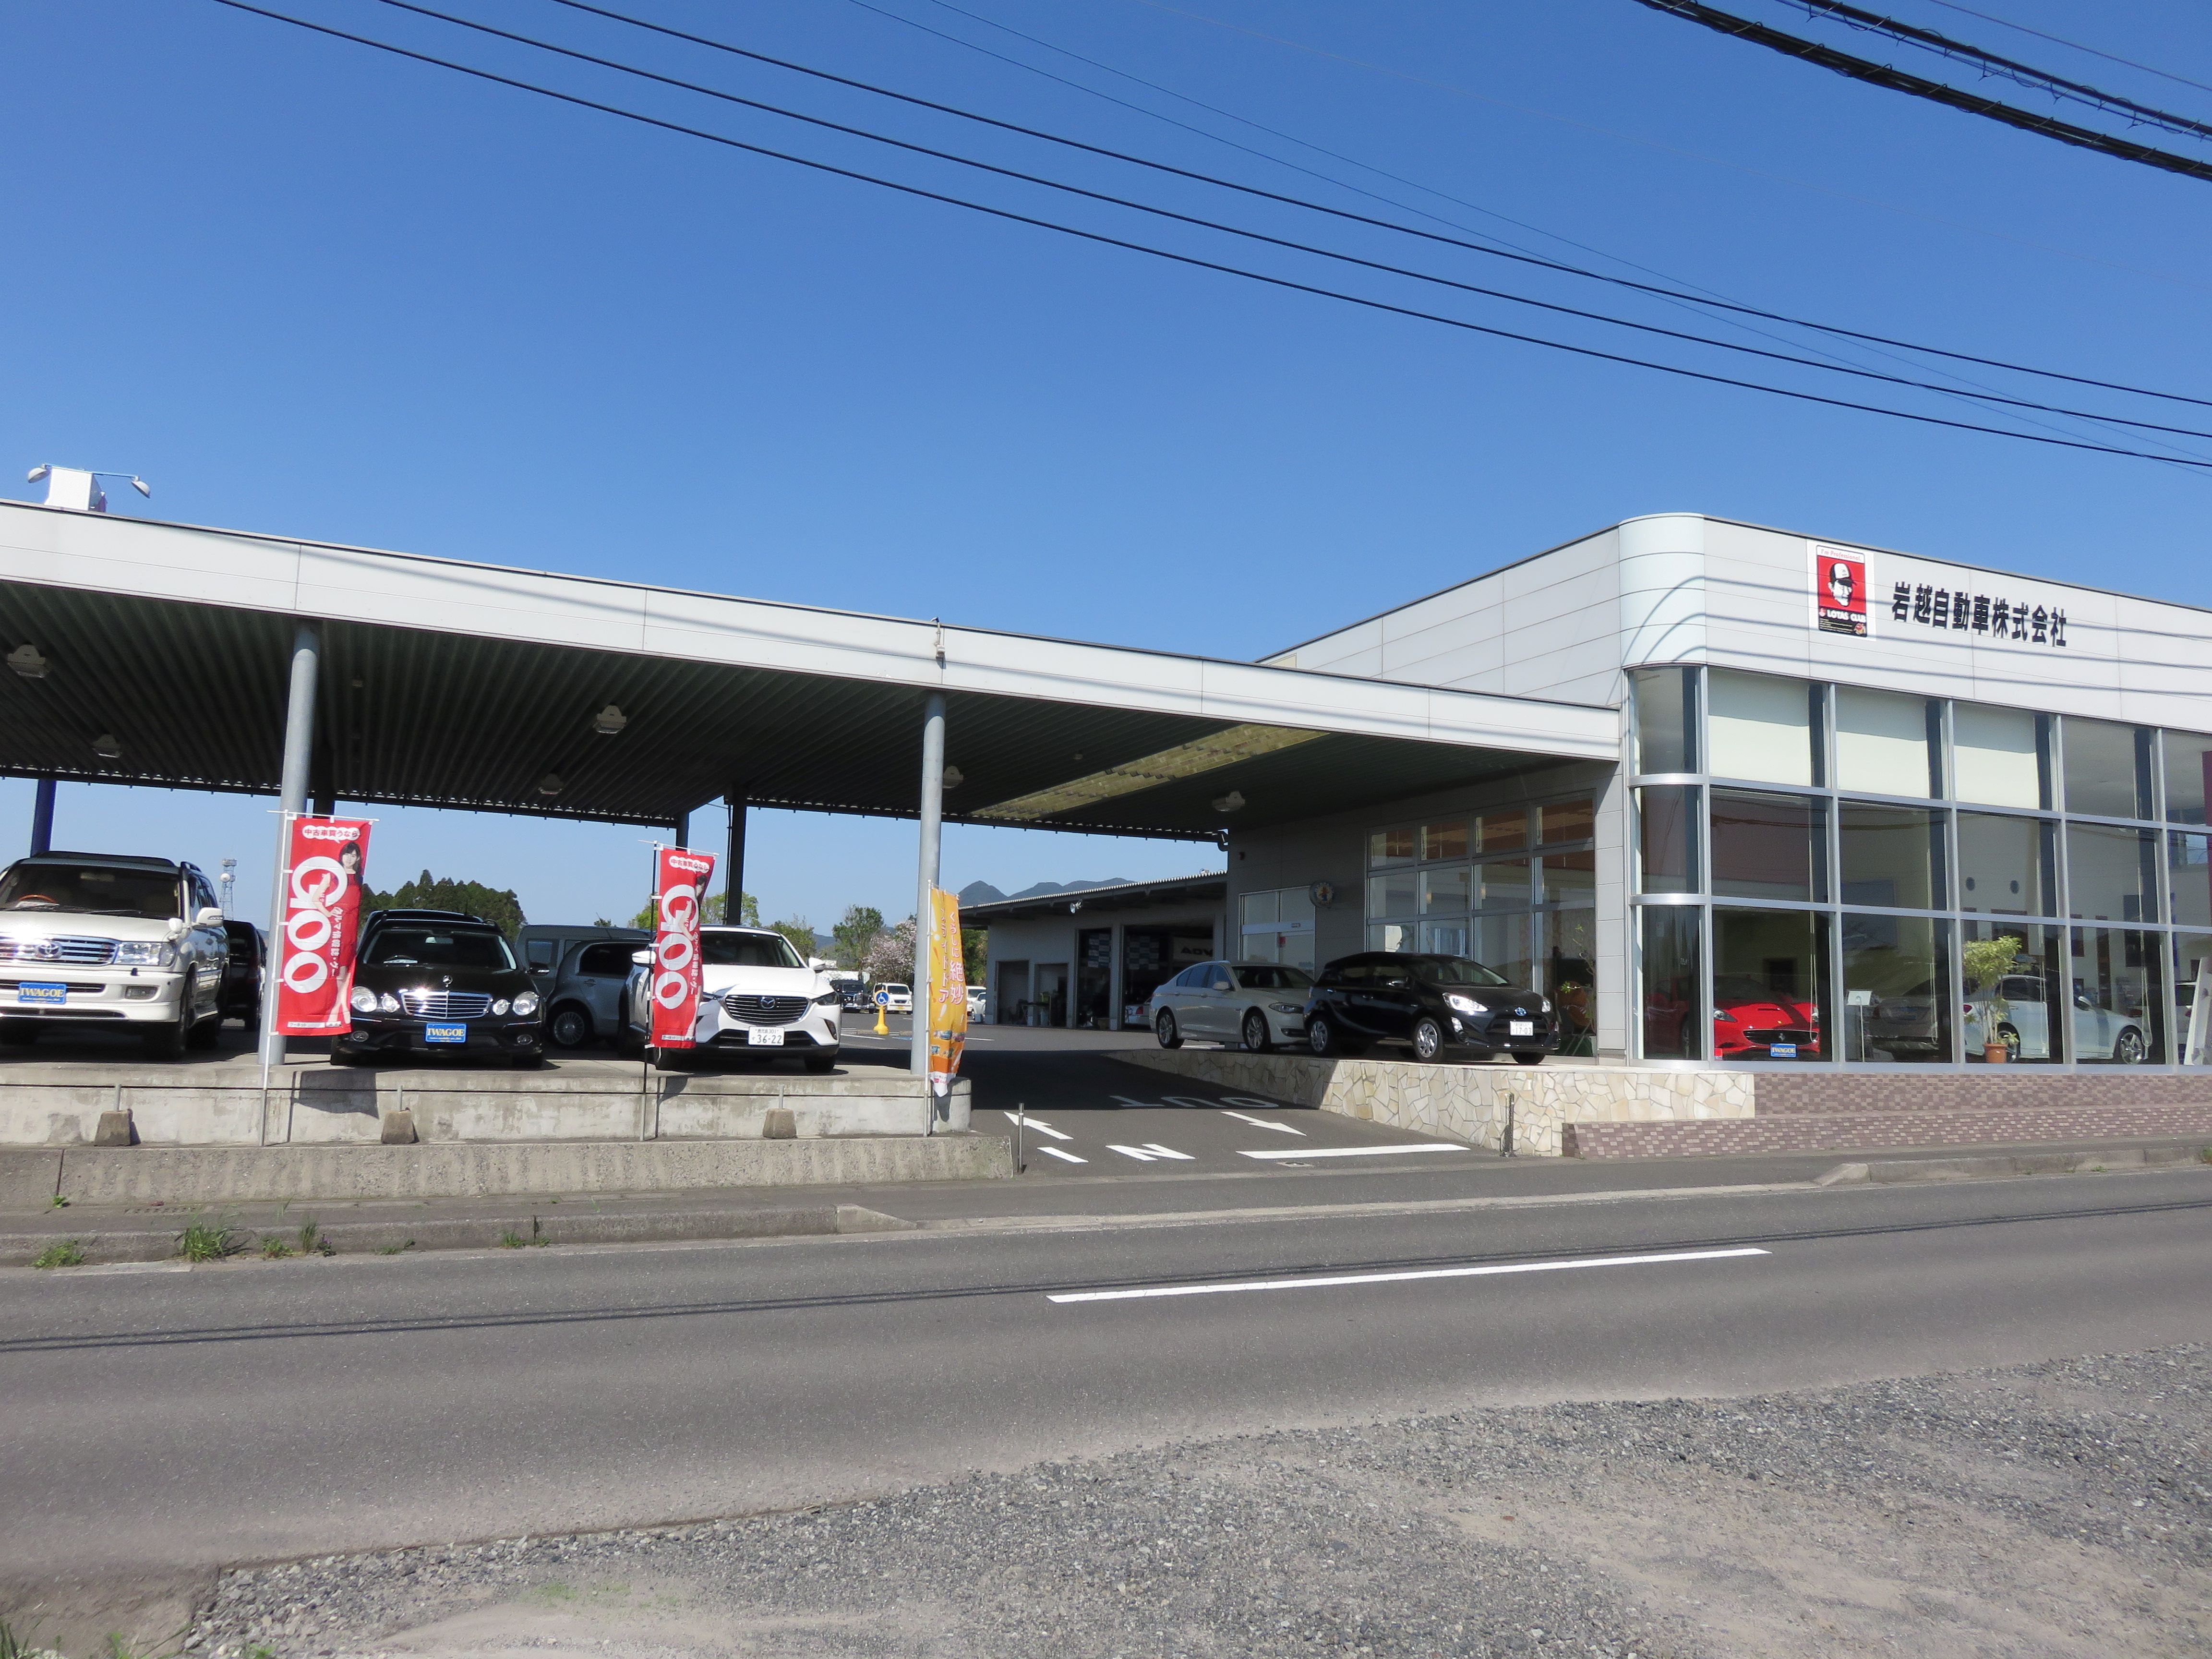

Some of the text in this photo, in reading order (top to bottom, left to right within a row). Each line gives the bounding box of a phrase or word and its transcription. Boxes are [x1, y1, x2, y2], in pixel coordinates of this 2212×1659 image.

[1827, 609, 1866, 624] LOTAS CLUB
[1892, 581, 2067, 647] 岩越自動車株式会社
[304, 828, 358, 838] 中古車買うなら
[949, 912, 964, 1005] くらしに絶妙
[427, 1028, 465, 1036] IWAGOE
[757, 1034, 782, 1044] 36-22
